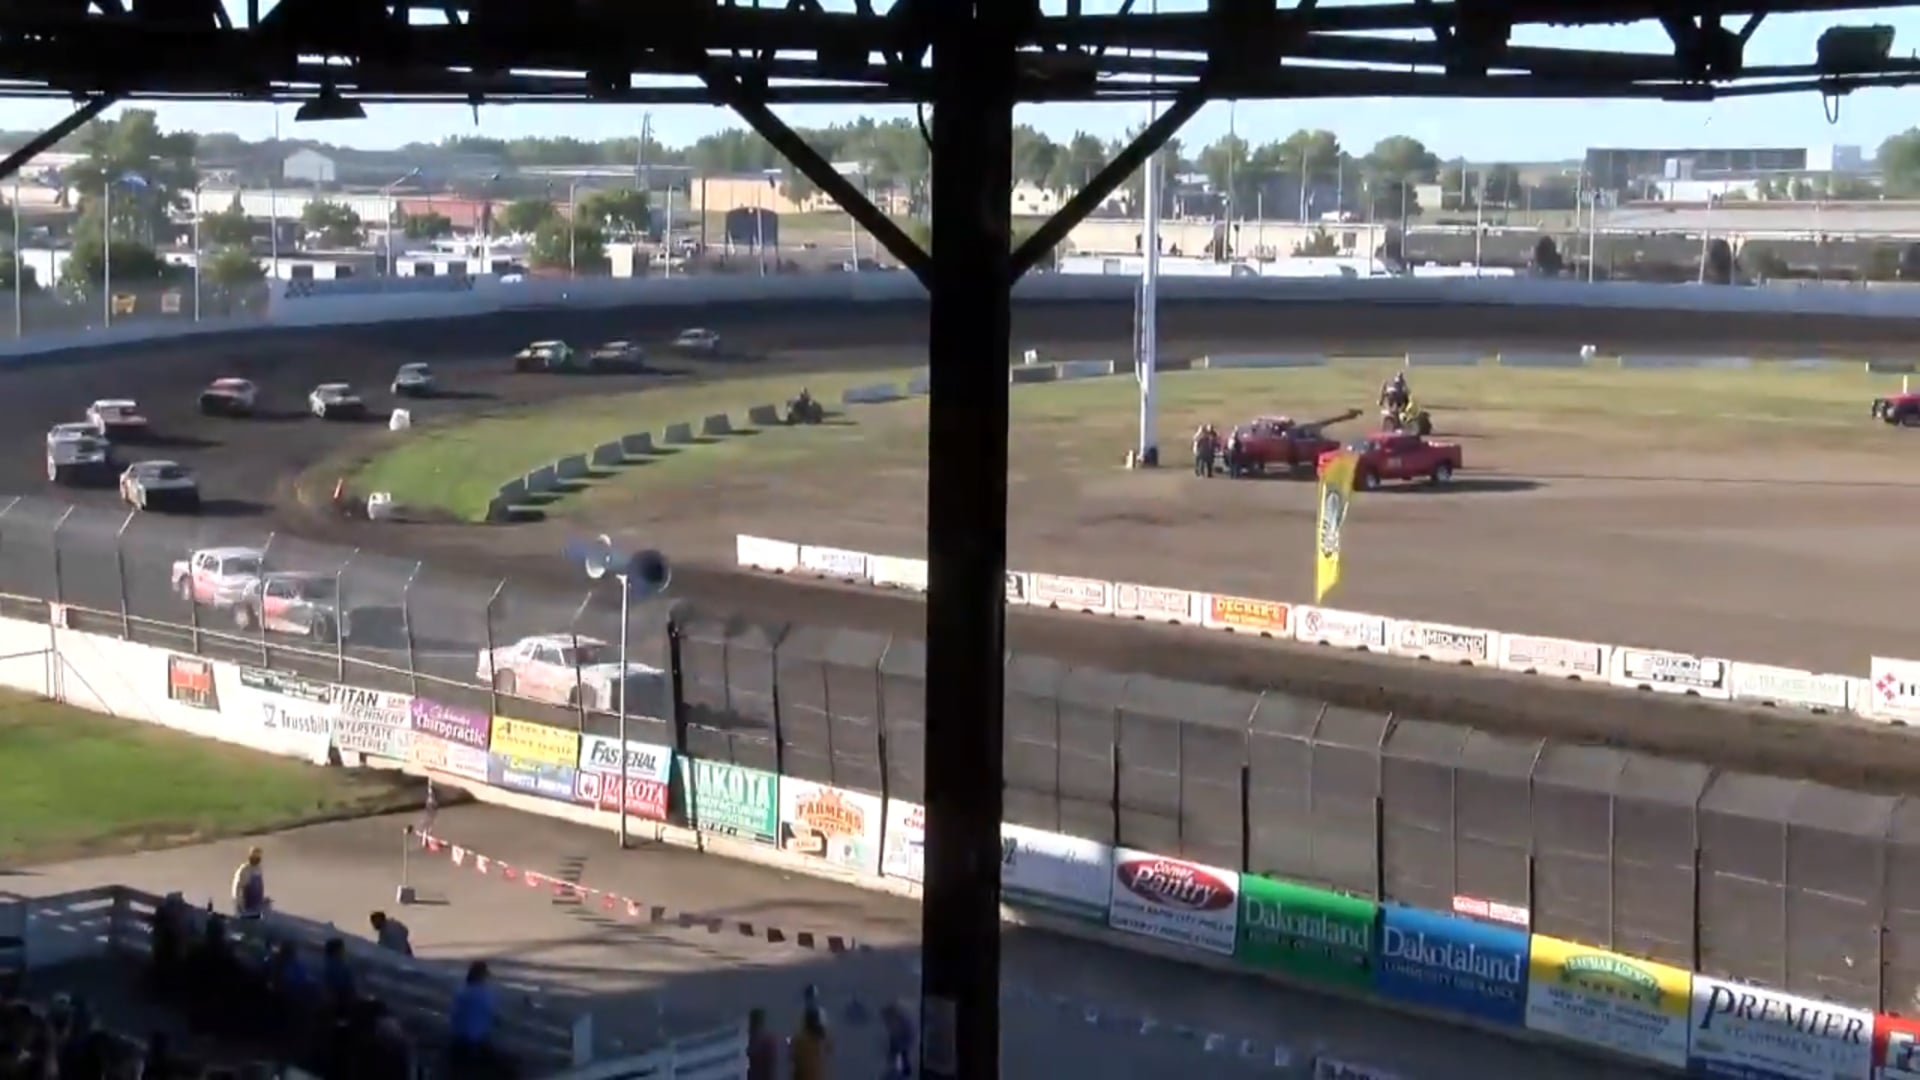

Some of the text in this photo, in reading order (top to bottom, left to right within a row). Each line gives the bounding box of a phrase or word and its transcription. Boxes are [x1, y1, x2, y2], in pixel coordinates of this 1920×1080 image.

[1424, 629, 1484, 651] MIDLAND
[332, 686, 379, 706] TITAN
[334, 718, 392, 740] INTERSTATE
[416, 712, 486, 746] Chiropractic
[590, 740, 658, 771] FASENAL
[695, 761, 769, 808] AKOTA
[798, 801, 863, 830] FARMERS
[1154, 860, 1194, 877] Corner
[1132, 866, 1219, 908] Pantry
[1245, 896, 1369, 951] Dakotaland
[1384, 926, 1520, 982] Dakotaland
[1699, 985, 1864, 1045] PREMIER
